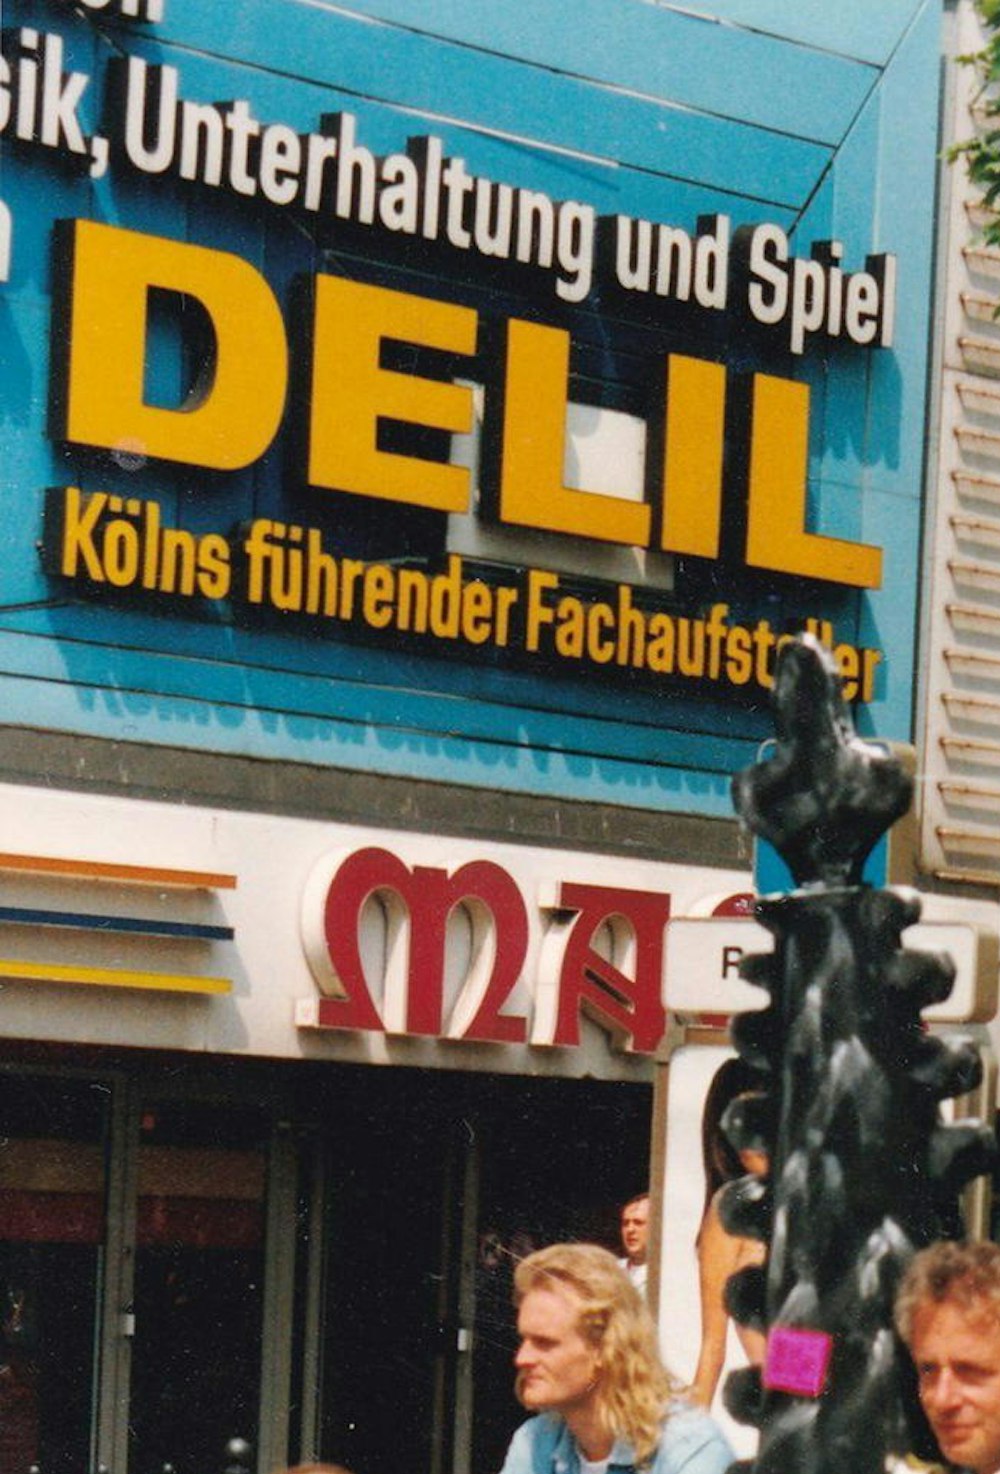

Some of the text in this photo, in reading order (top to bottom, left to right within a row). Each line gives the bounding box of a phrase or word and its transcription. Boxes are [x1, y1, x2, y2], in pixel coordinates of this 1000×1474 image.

[0, 27, 110, 179] ik,
[125, 55, 593, 303] Unterhaltung
[615, 213, 727, 311] und
[748, 222, 897, 354] Spiel
[65, 218, 883, 592] DELIL
[62, 487, 881, 703] Kölns führender Fachaufster
